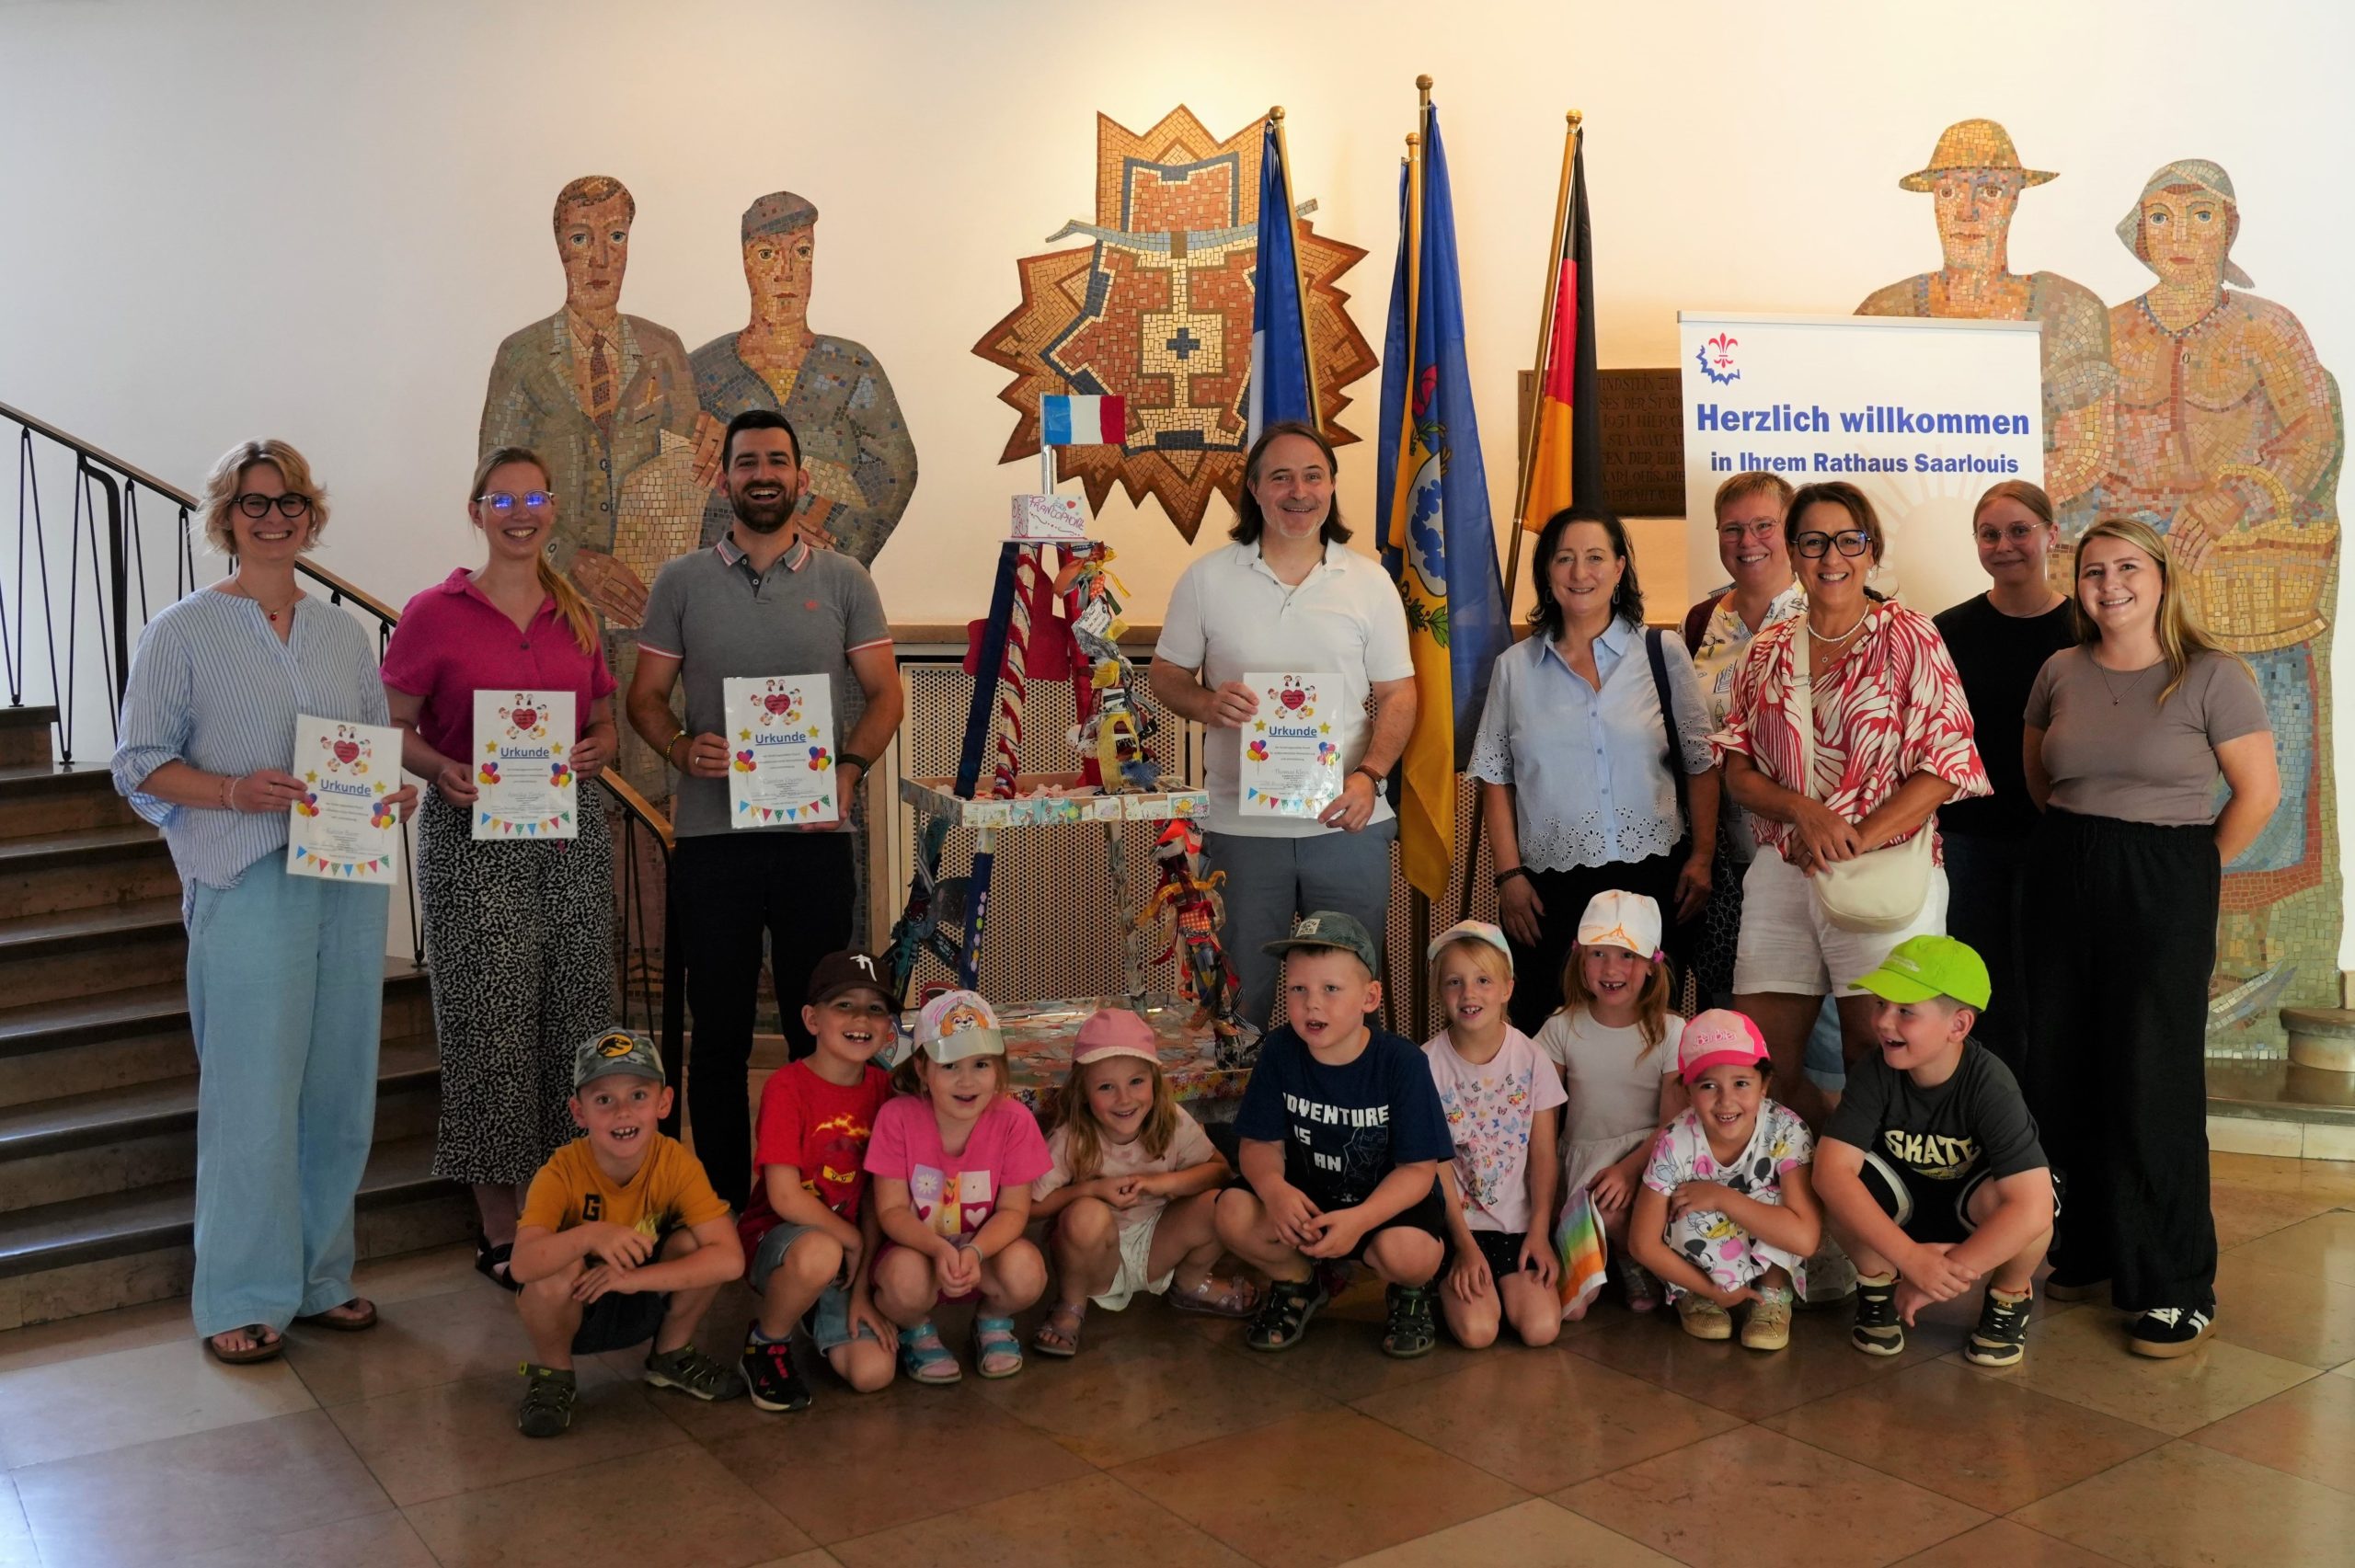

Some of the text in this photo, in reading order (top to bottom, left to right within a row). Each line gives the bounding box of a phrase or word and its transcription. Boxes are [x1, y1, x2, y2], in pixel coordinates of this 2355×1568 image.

[1697, 403, 2029, 435] Herzlich willkommen
[1711, 451, 2019, 475] in Ihrem Rathaus Saarlouis
[755, 731, 807, 745] Urkunde
[1269, 725, 1317, 737] Urkunde
[500, 746, 550, 758] Urkunde
[320, 779, 372, 796] Urkunde
[1696, 1029, 1738, 1046] Barbie
[1293, 1125, 1312, 1146] IS
[1884, 1129, 1982, 1167] SKATE
[1314, 1151, 1341, 1173] AN
[582, 1192, 601, 1221] G
